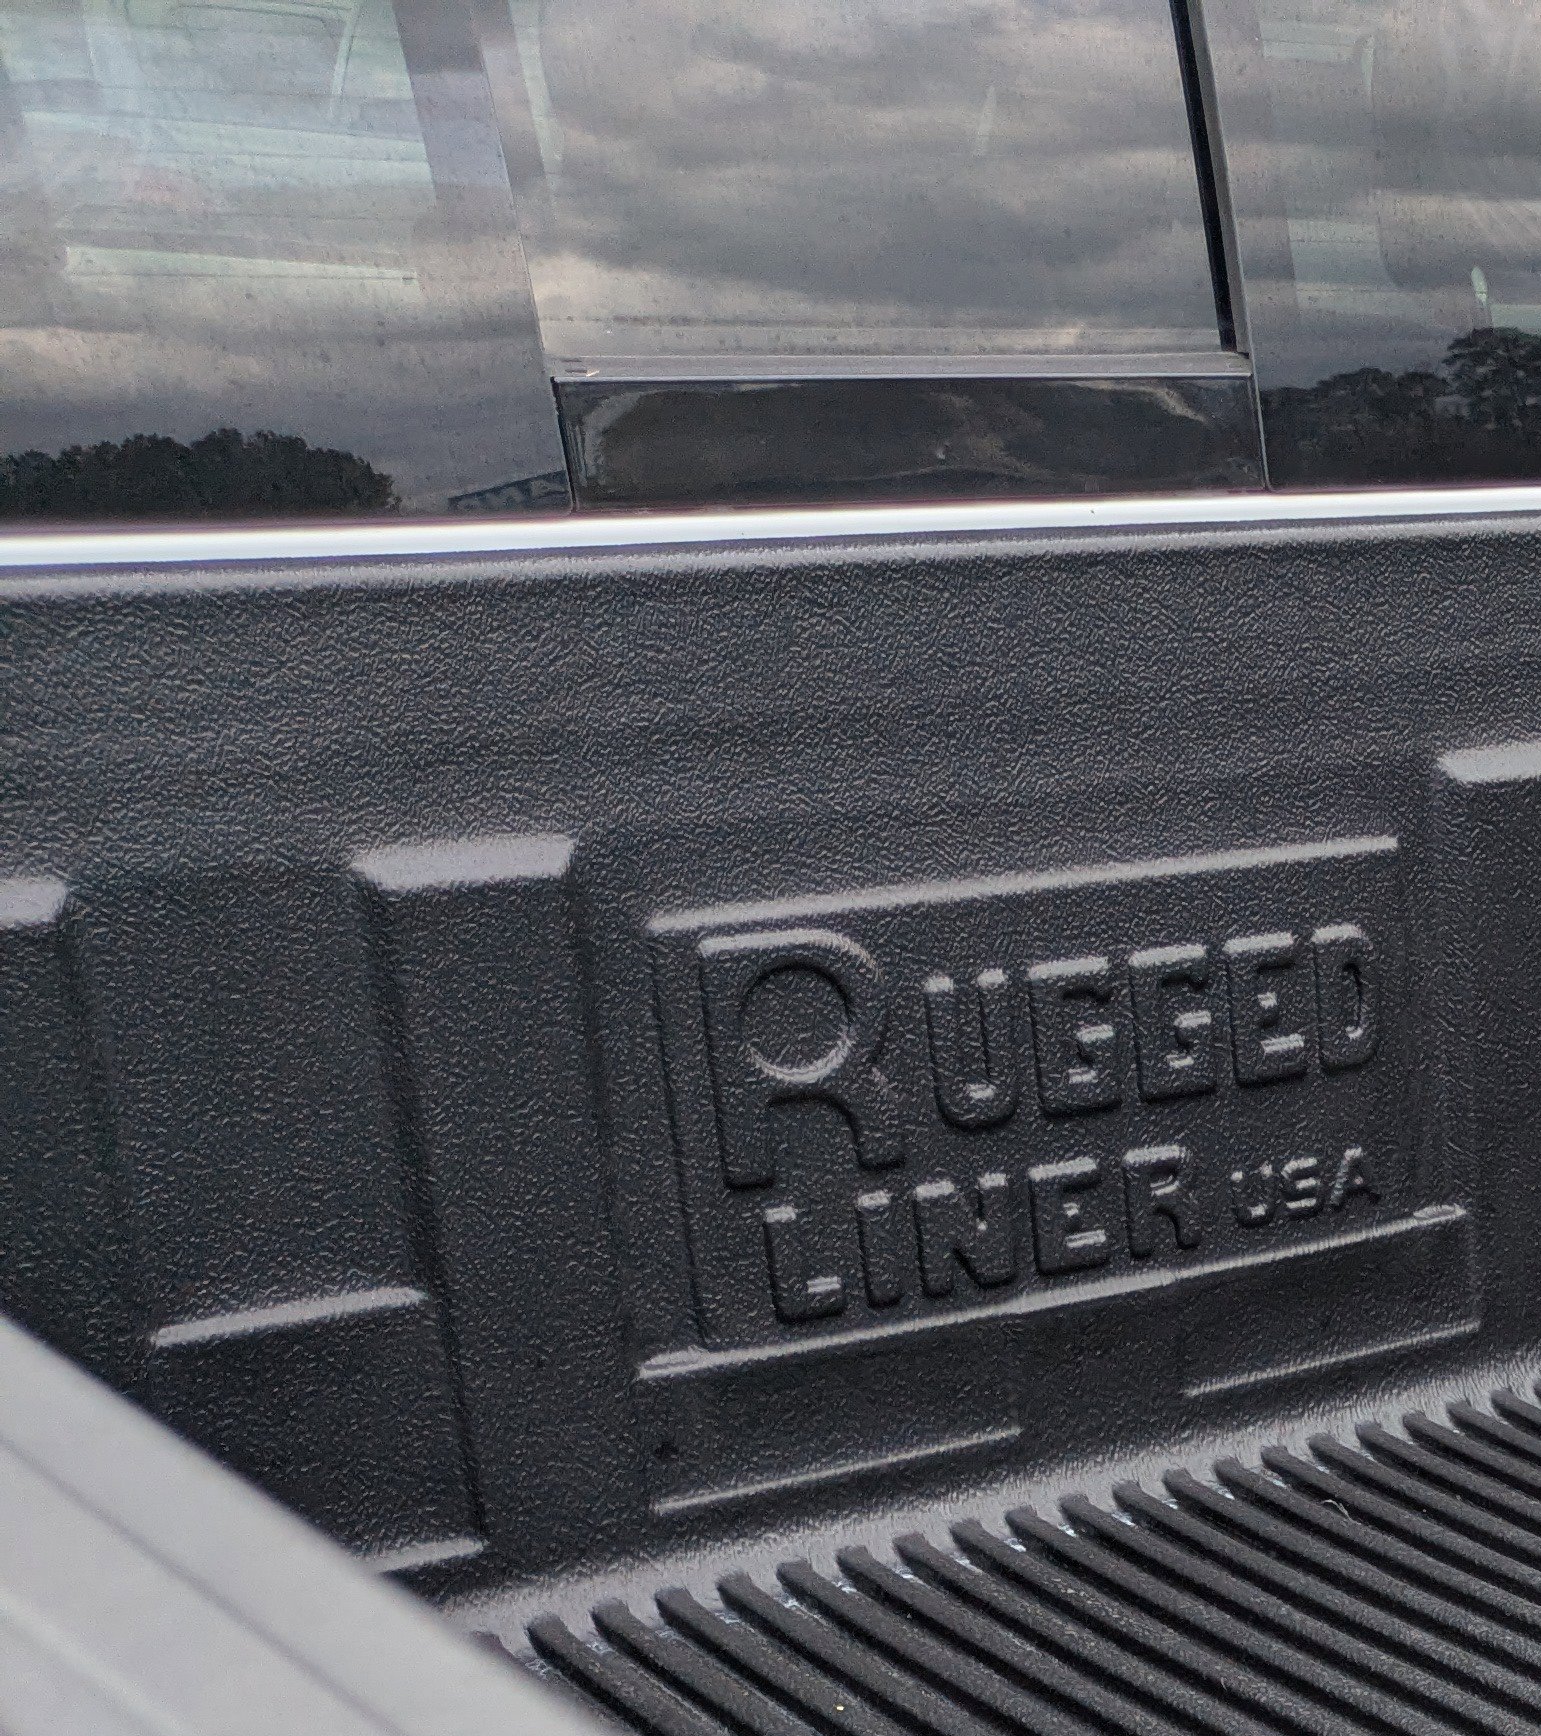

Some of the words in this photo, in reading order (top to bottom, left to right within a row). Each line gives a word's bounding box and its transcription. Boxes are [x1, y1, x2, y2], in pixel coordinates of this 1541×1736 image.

[698, 925, 1379, 1191] RUGGED
[763, 1144, 1199, 1324] LINER
[1229, 1146, 1382, 1230] USA
